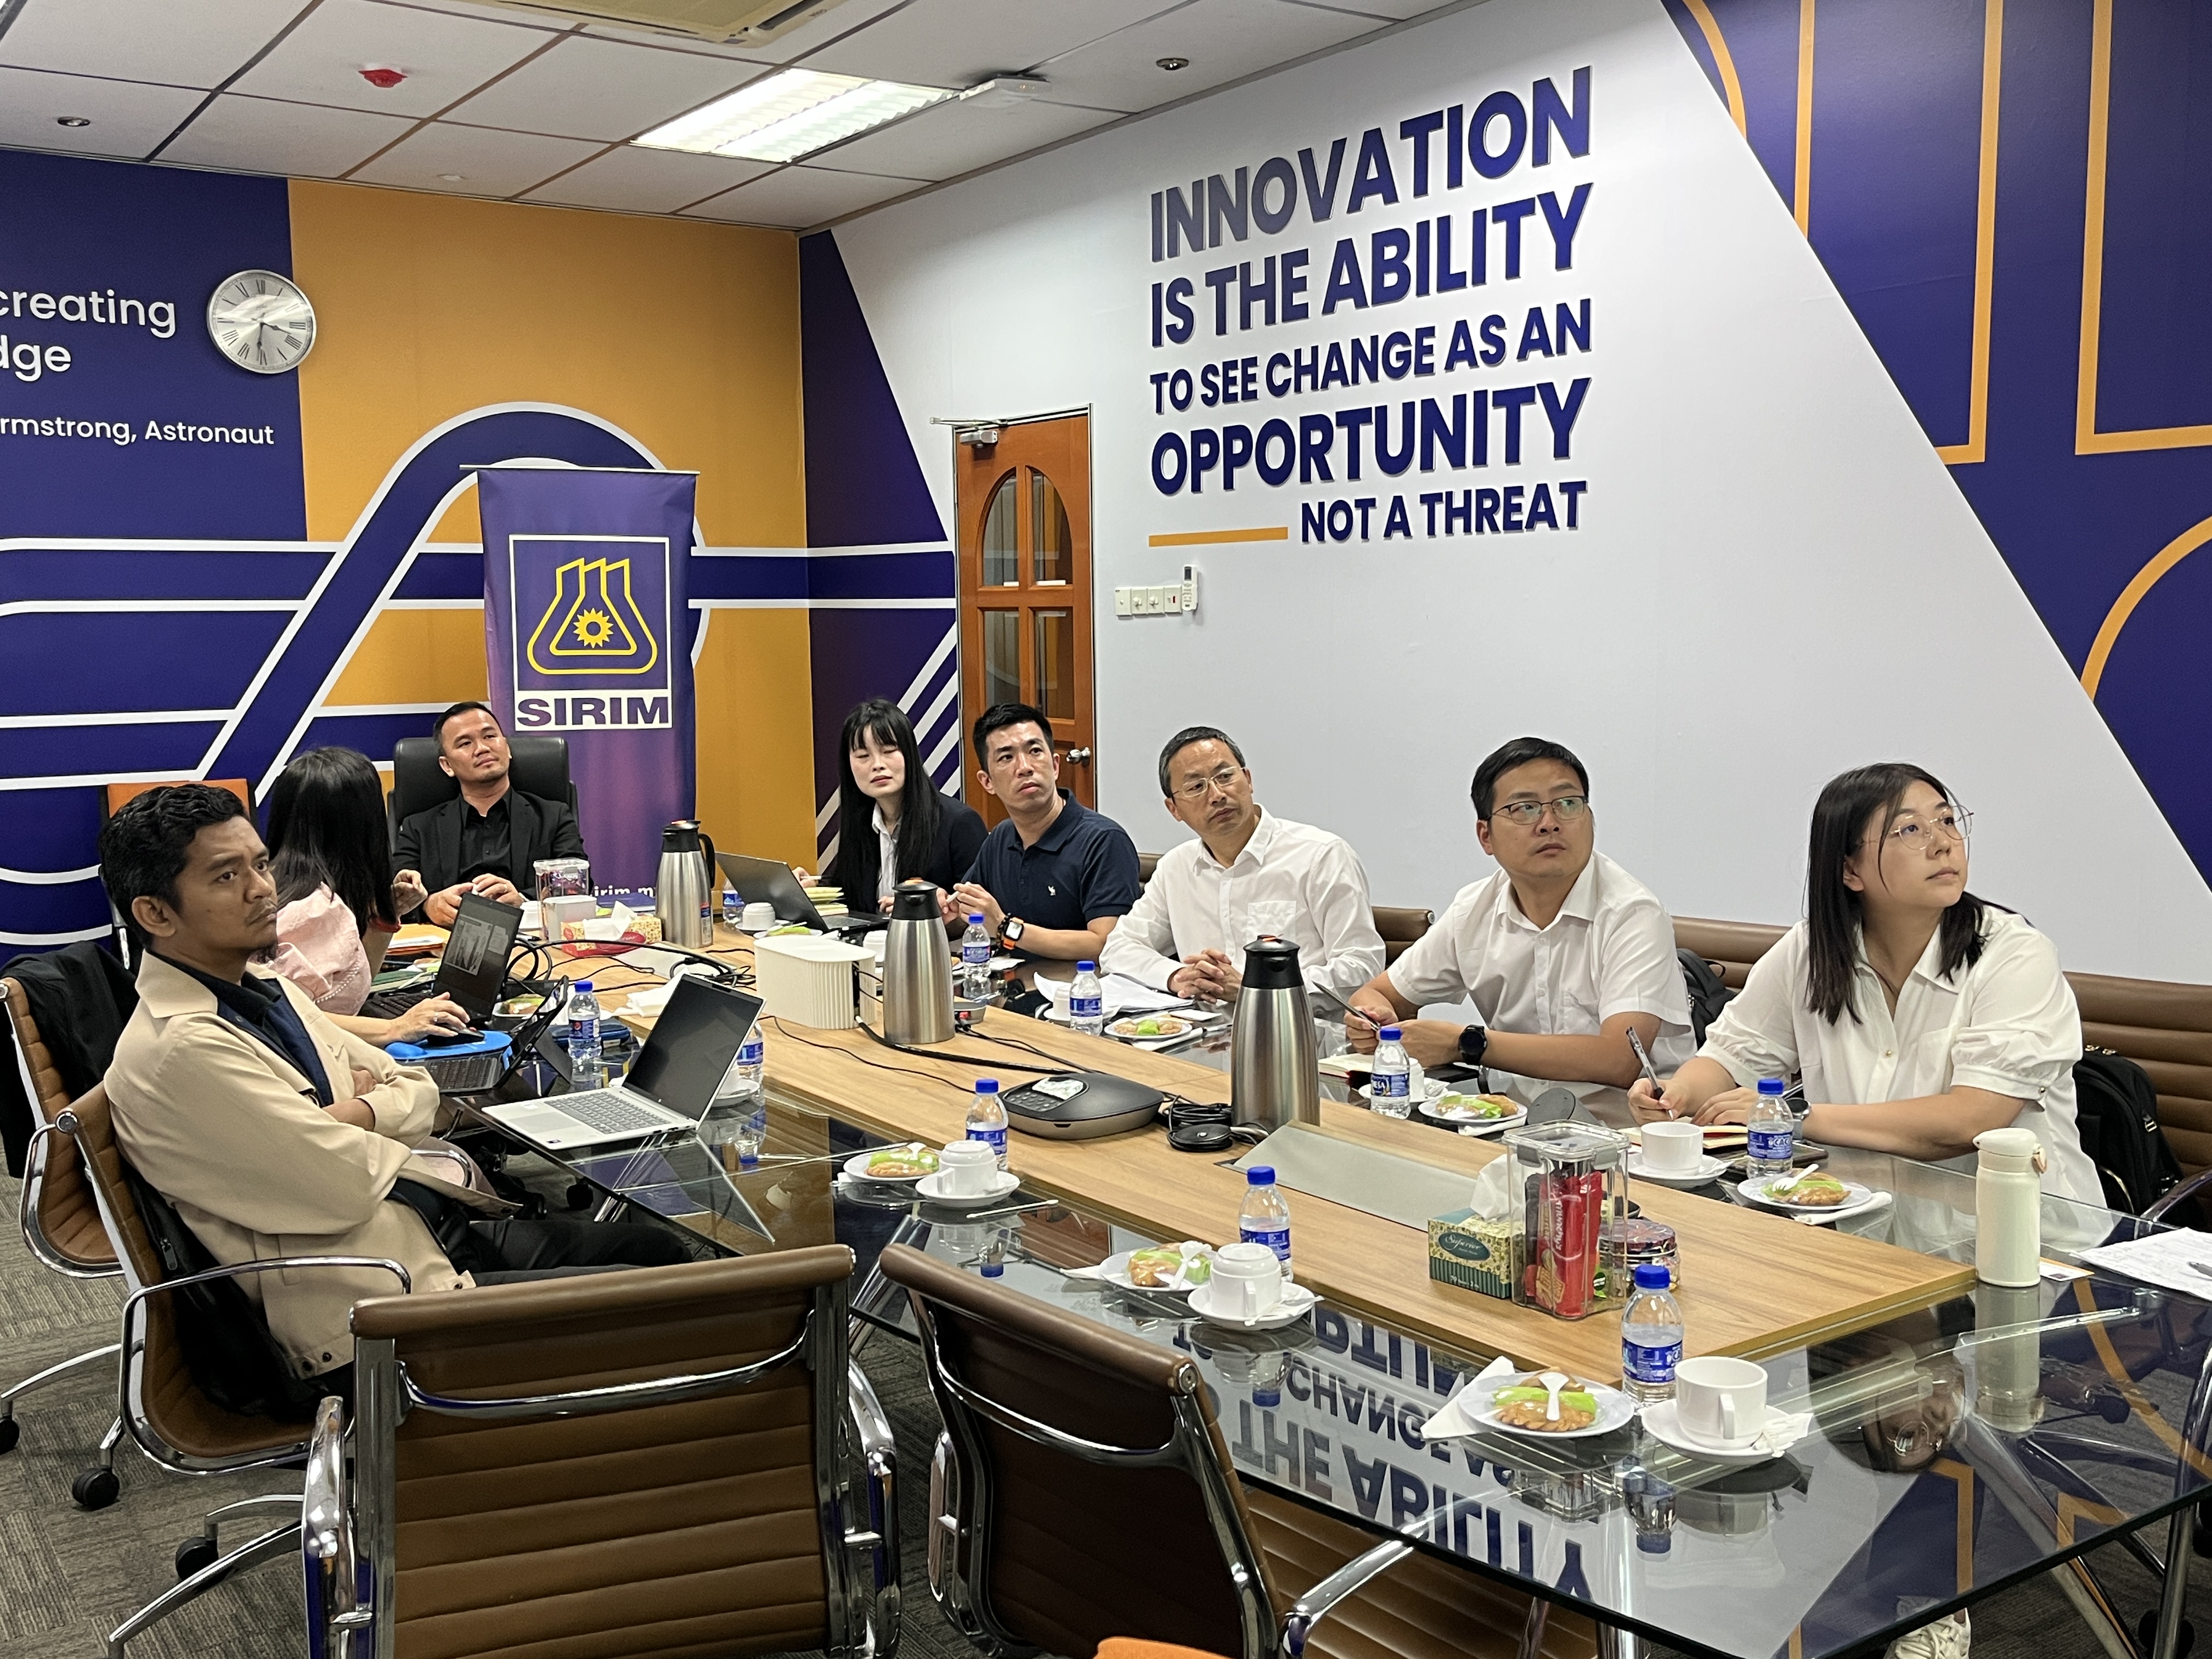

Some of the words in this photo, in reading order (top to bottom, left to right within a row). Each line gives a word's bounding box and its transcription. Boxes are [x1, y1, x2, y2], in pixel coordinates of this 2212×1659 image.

[1151, 65, 1593, 263] INNOVATION
[1151, 278, 1196, 349] IS
[1205, 248, 1310, 337] THE
[1321, 182, 1594, 317] ABILITY
[1150, 369, 1194, 416] TO
[1200, 356, 1260, 408] SEE
[1266, 325, 1437, 398] CHANGE
[1444, 314, 1508, 373] AS
[1516, 298, 1593, 362] AN
[0, 416, 138, 446] rmstrong,
[144, 420, 275, 445] Astronaut
[1151, 377, 1593, 496] OPPORTUNITY
[1301, 497, 1378, 544] NOT
[1383, 495, 1414, 540] A
[1419, 480, 1588, 539] THREAT
[517, 696, 669, 727] SIRIM
[1443, 1233, 1481, 1251] Superior
